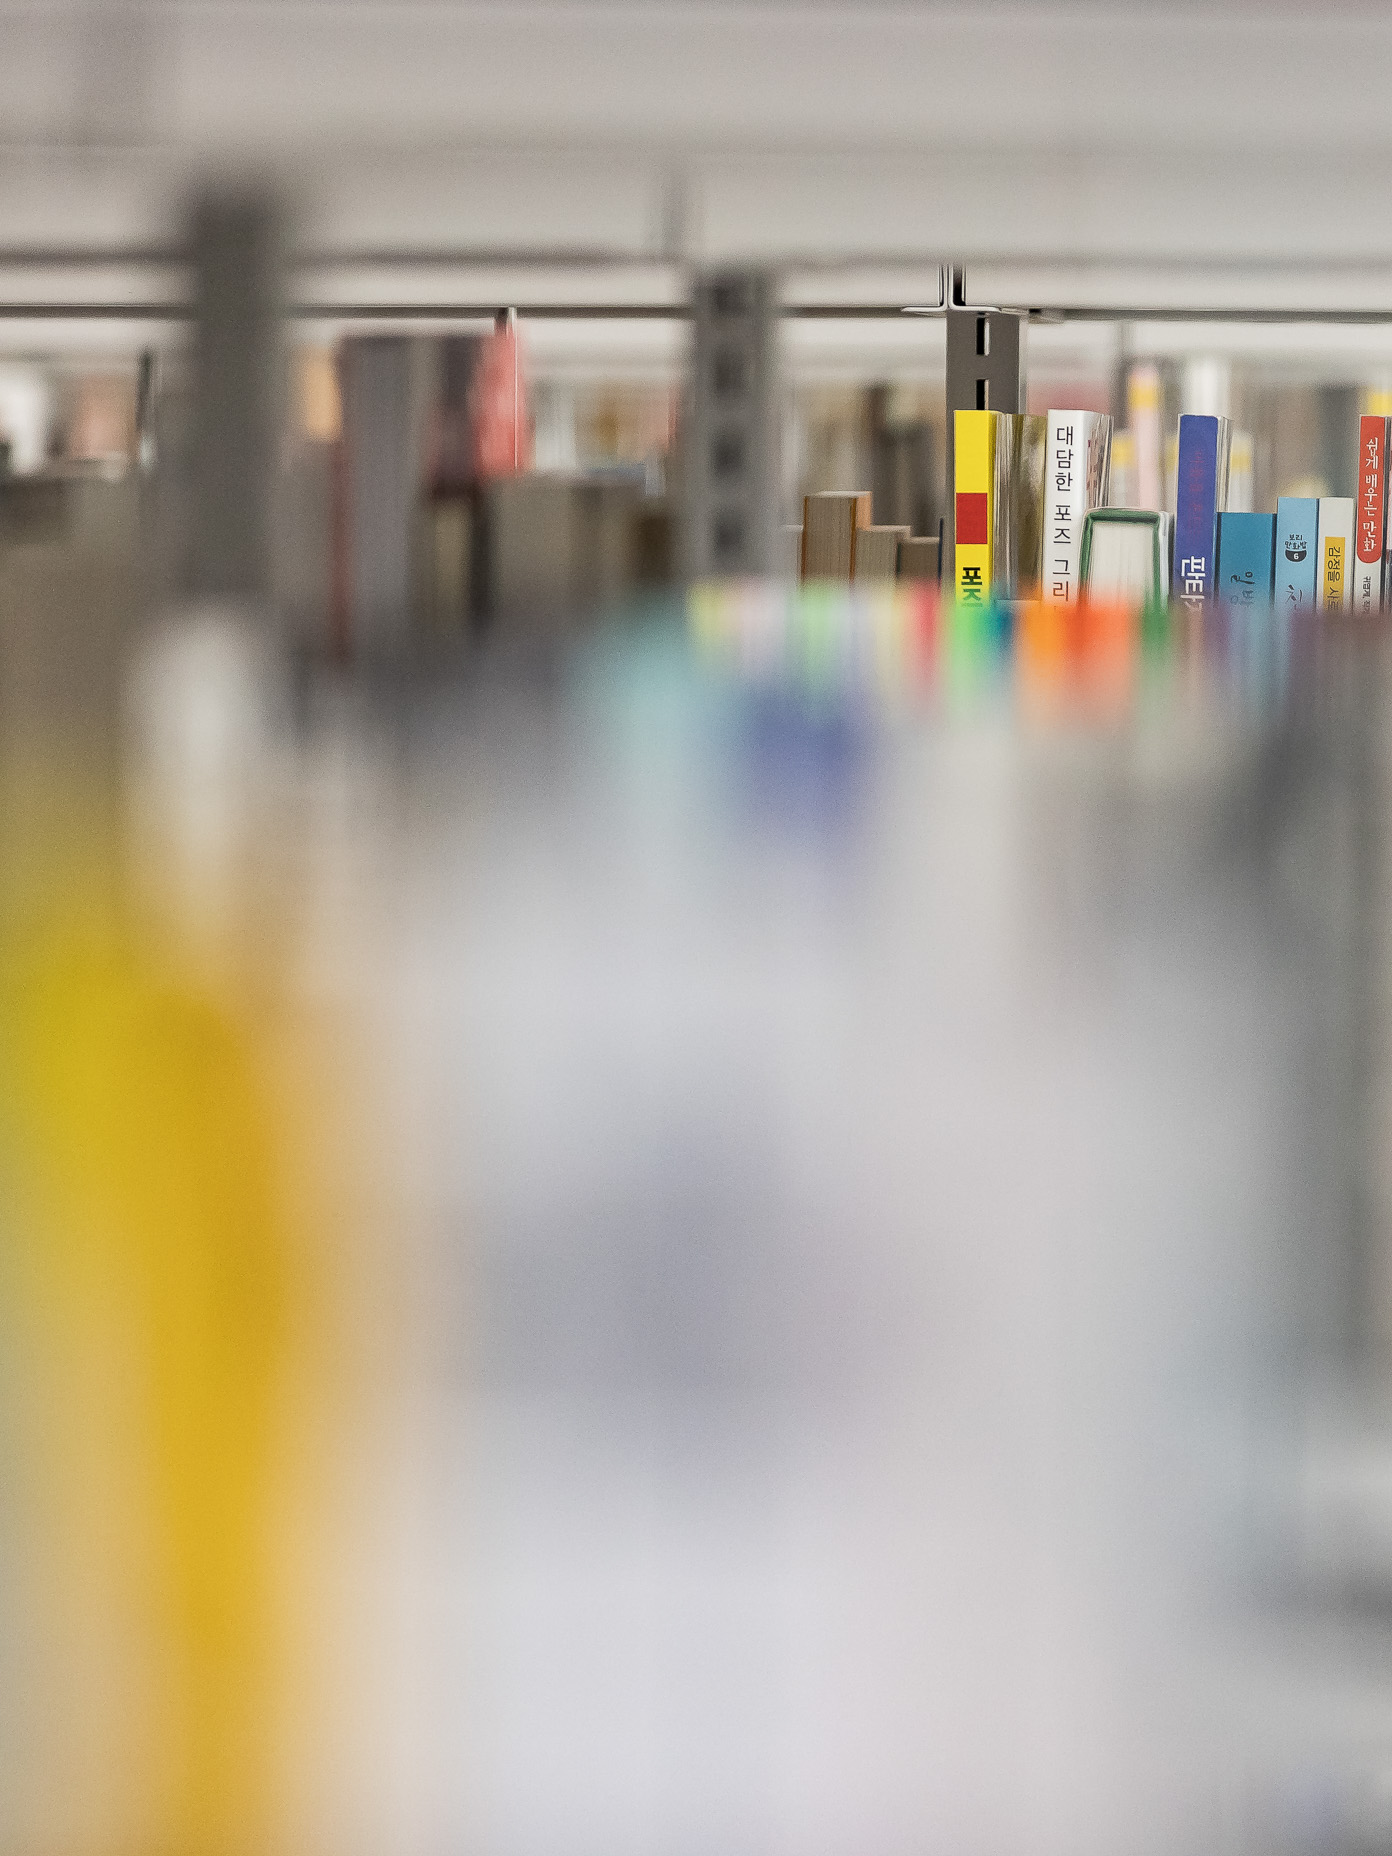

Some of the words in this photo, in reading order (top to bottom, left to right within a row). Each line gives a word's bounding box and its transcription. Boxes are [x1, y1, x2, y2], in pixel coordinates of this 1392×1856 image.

[1054, 426, 1074, 492] 대담한
[1365, 437, 1379, 470] 쉽게
[1363, 474, 1378, 516] 배우는
[1053, 504, 1072, 545] 포즈
[1362, 521, 1377, 553] 만화
[1285, 540, 1308, 550] 만화밥
[1327, 546, 1341, 582] 감정을
[961, 567, 983, 607] 포즈
